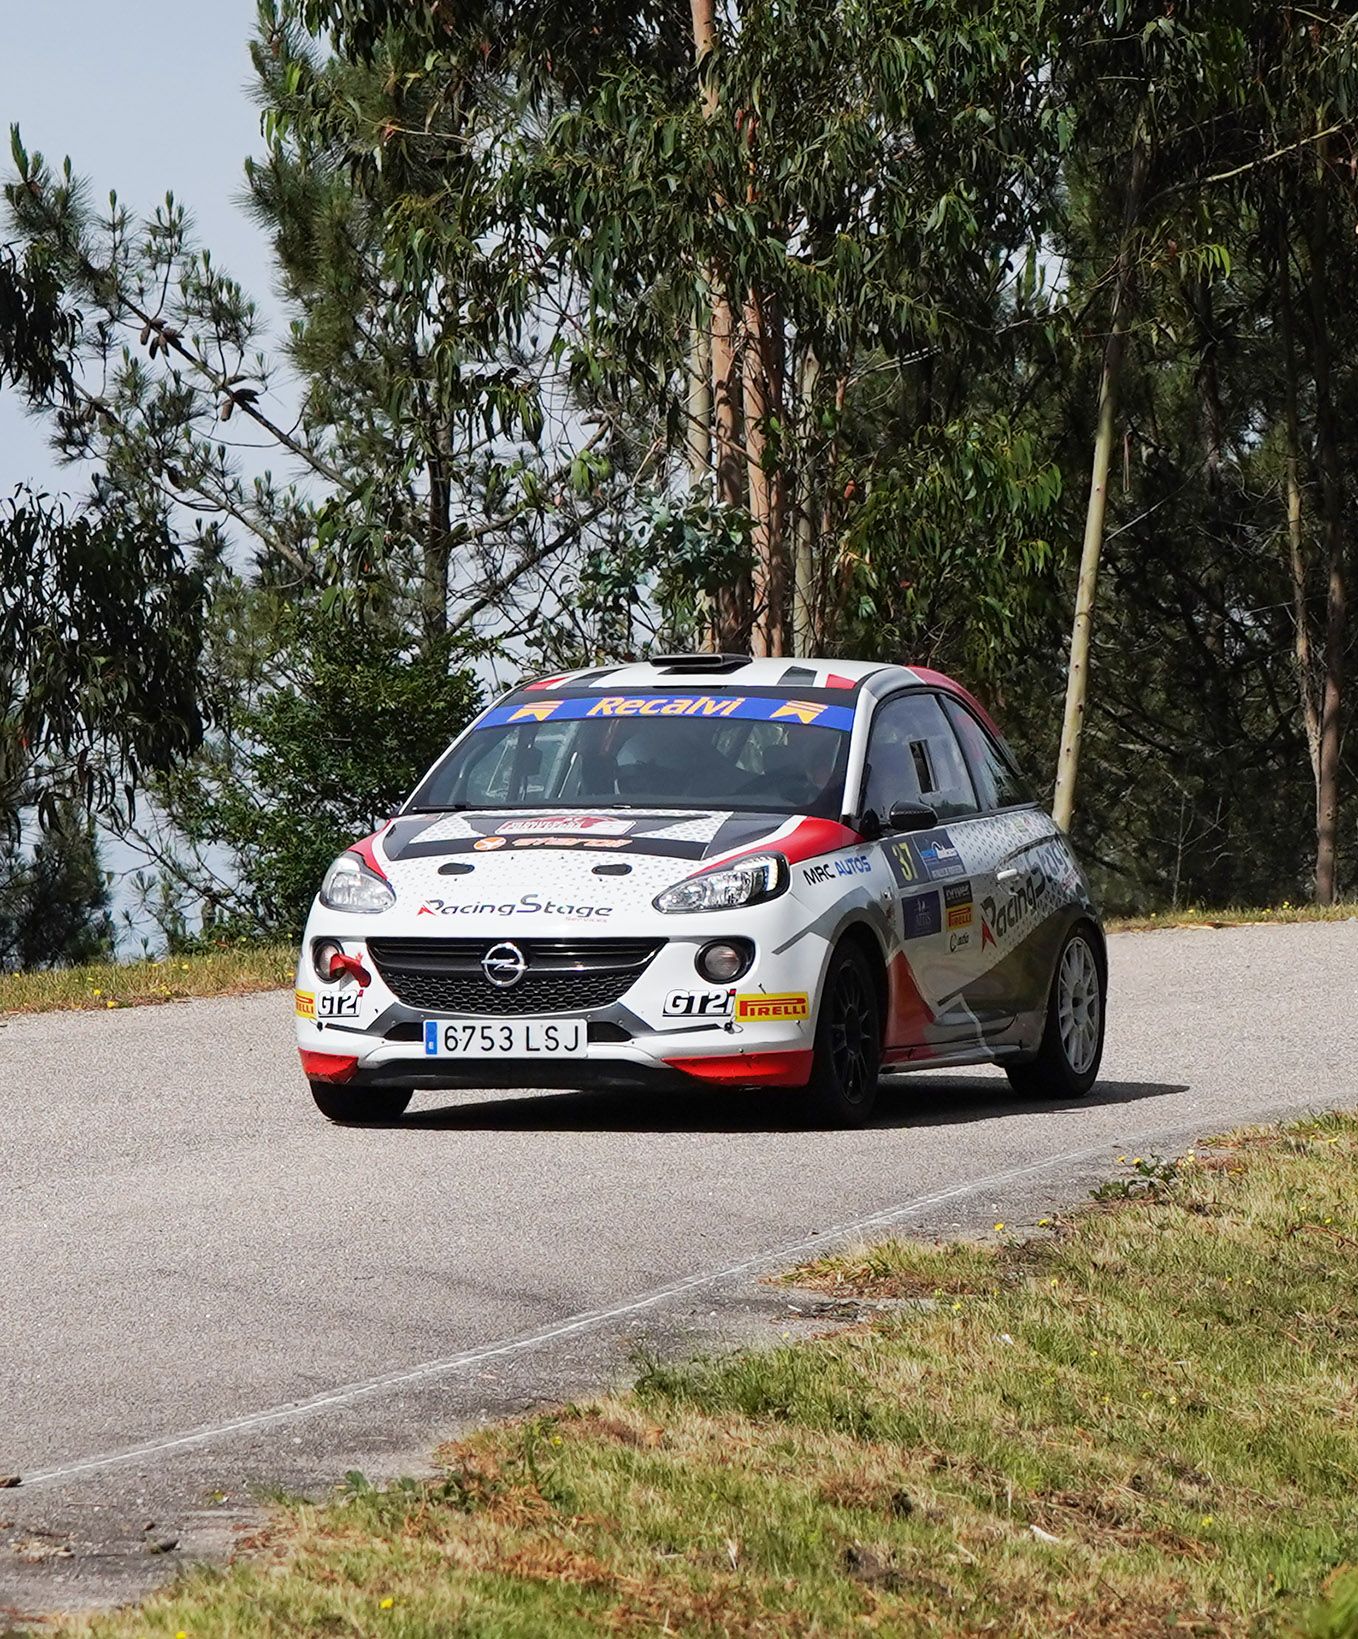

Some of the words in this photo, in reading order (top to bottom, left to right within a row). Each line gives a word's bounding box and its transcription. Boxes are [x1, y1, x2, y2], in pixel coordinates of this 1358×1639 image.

[586, 696, 746, 716] Recalvi
[803, 863, 836, 886] MRC
[834, 855, 872, 876] AUTOS
[891, 842, 919, 881] 37
[416, 894, 613, 917] RacingStage
[318, 989, 364, 1017] GT2i
[662, 989, 737, 1016] GT2i
[739, 998, 806, 1016] PIRELLI
[444, 1026, 513, 1051] 6753
[526, 1026, 578, 1051] LSJ
